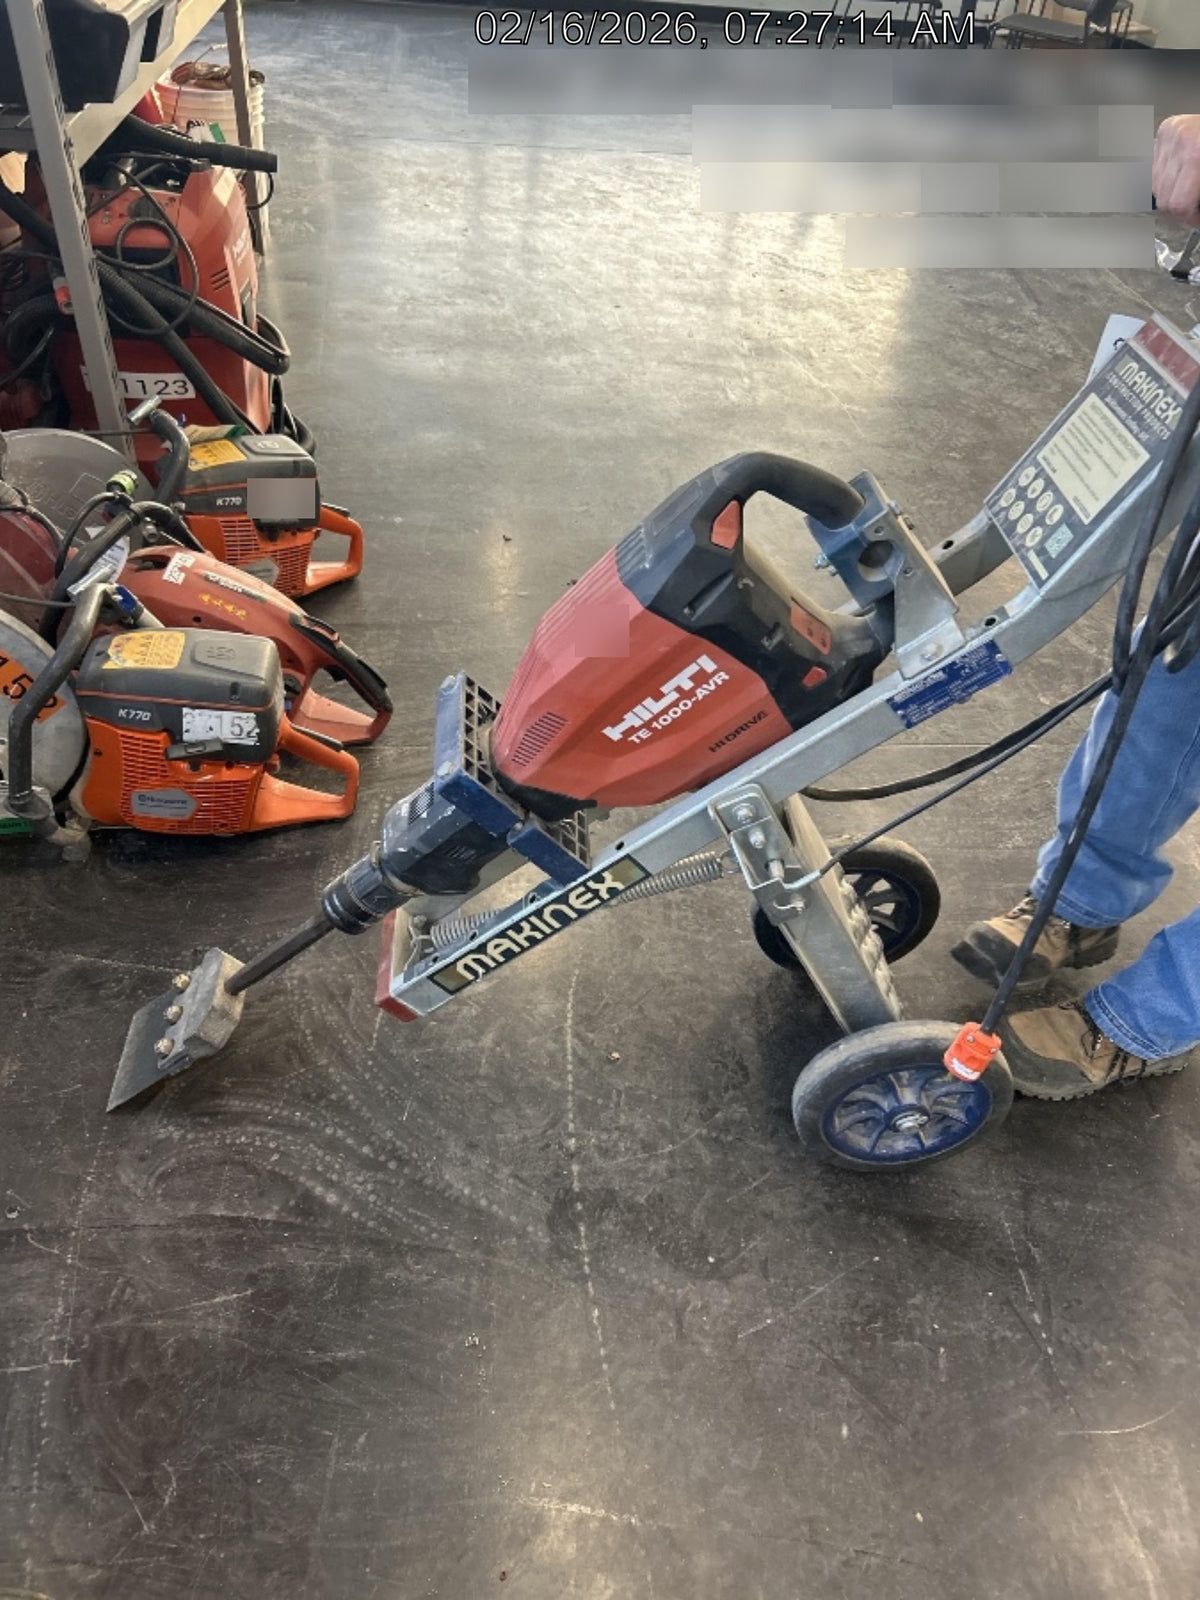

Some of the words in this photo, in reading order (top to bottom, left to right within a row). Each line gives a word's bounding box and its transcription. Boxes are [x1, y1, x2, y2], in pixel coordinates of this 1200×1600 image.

[1120, 362, 1183, 424] MAKINEX
[216, 496, 242, 506] K770
[118, 707, 151, 721] K770
[601, 654, 718, 742] HILTI
[628, 728, 653, 744] TE
[652, 671, 730, 730] 1000-AVR
[456, 870, 625, 982] MAKINEX
